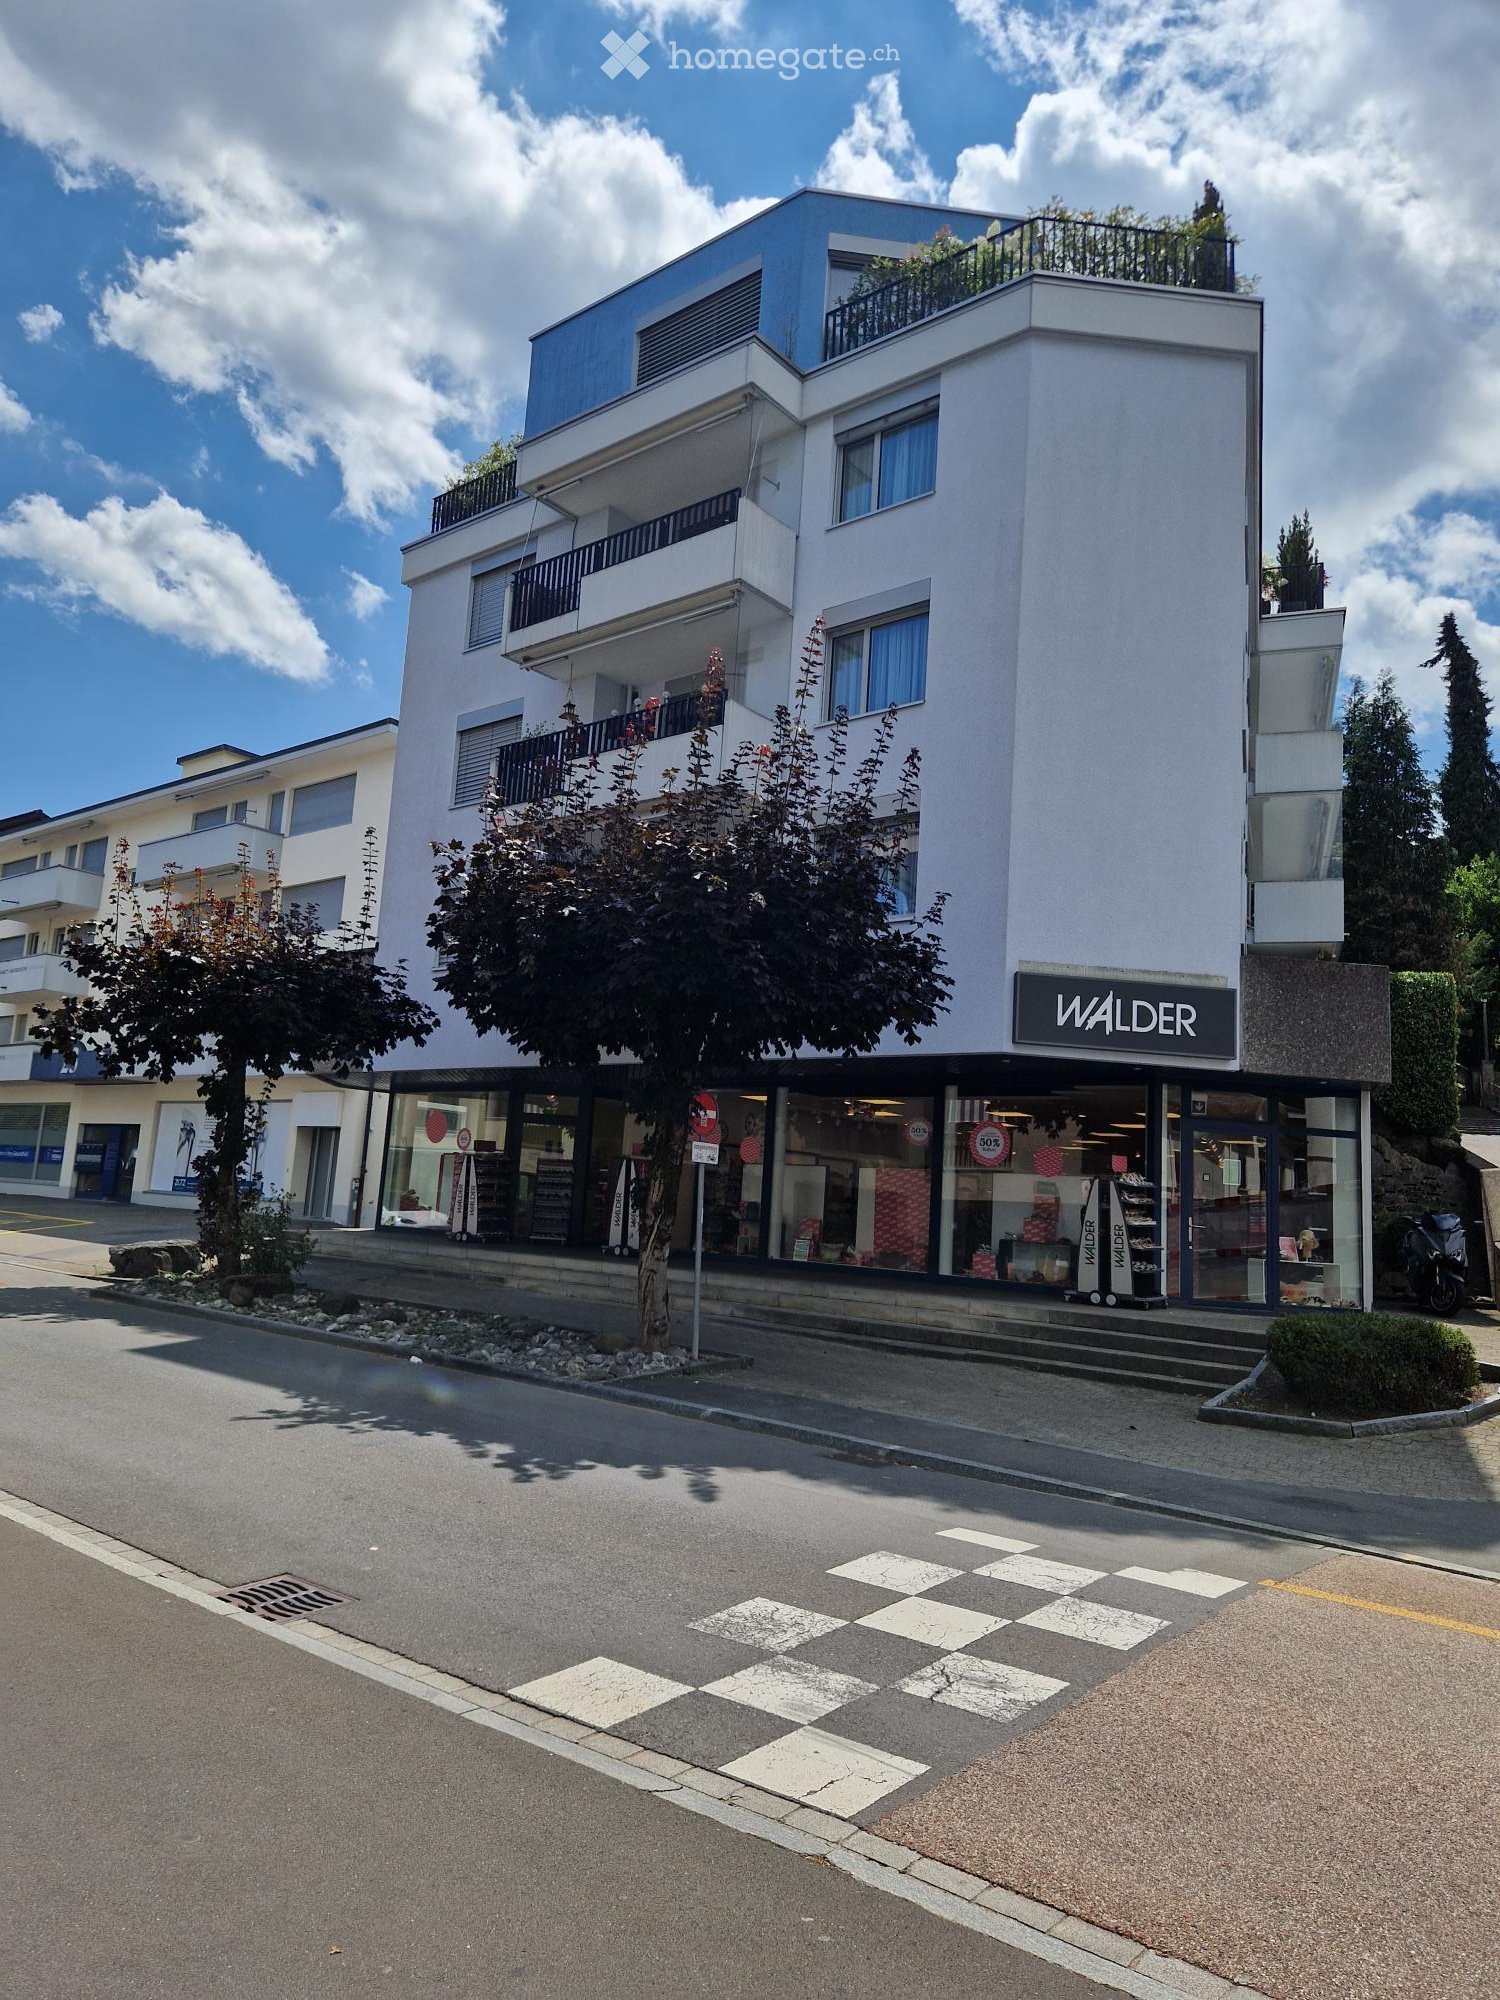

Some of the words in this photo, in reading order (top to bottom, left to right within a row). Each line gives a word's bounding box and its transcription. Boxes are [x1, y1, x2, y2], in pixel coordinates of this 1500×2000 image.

[1056, 990, 1197, 1037] WALDER
[979, 1137, 1001, 1148] 50%
[469, 1185, 477, 1216] WALDER
[614, 1192, 622, 1227] WALDER
[1084, 1219, 1096, 1265] WALDER
[1114, 1224, 1125, 1268] WALDER
